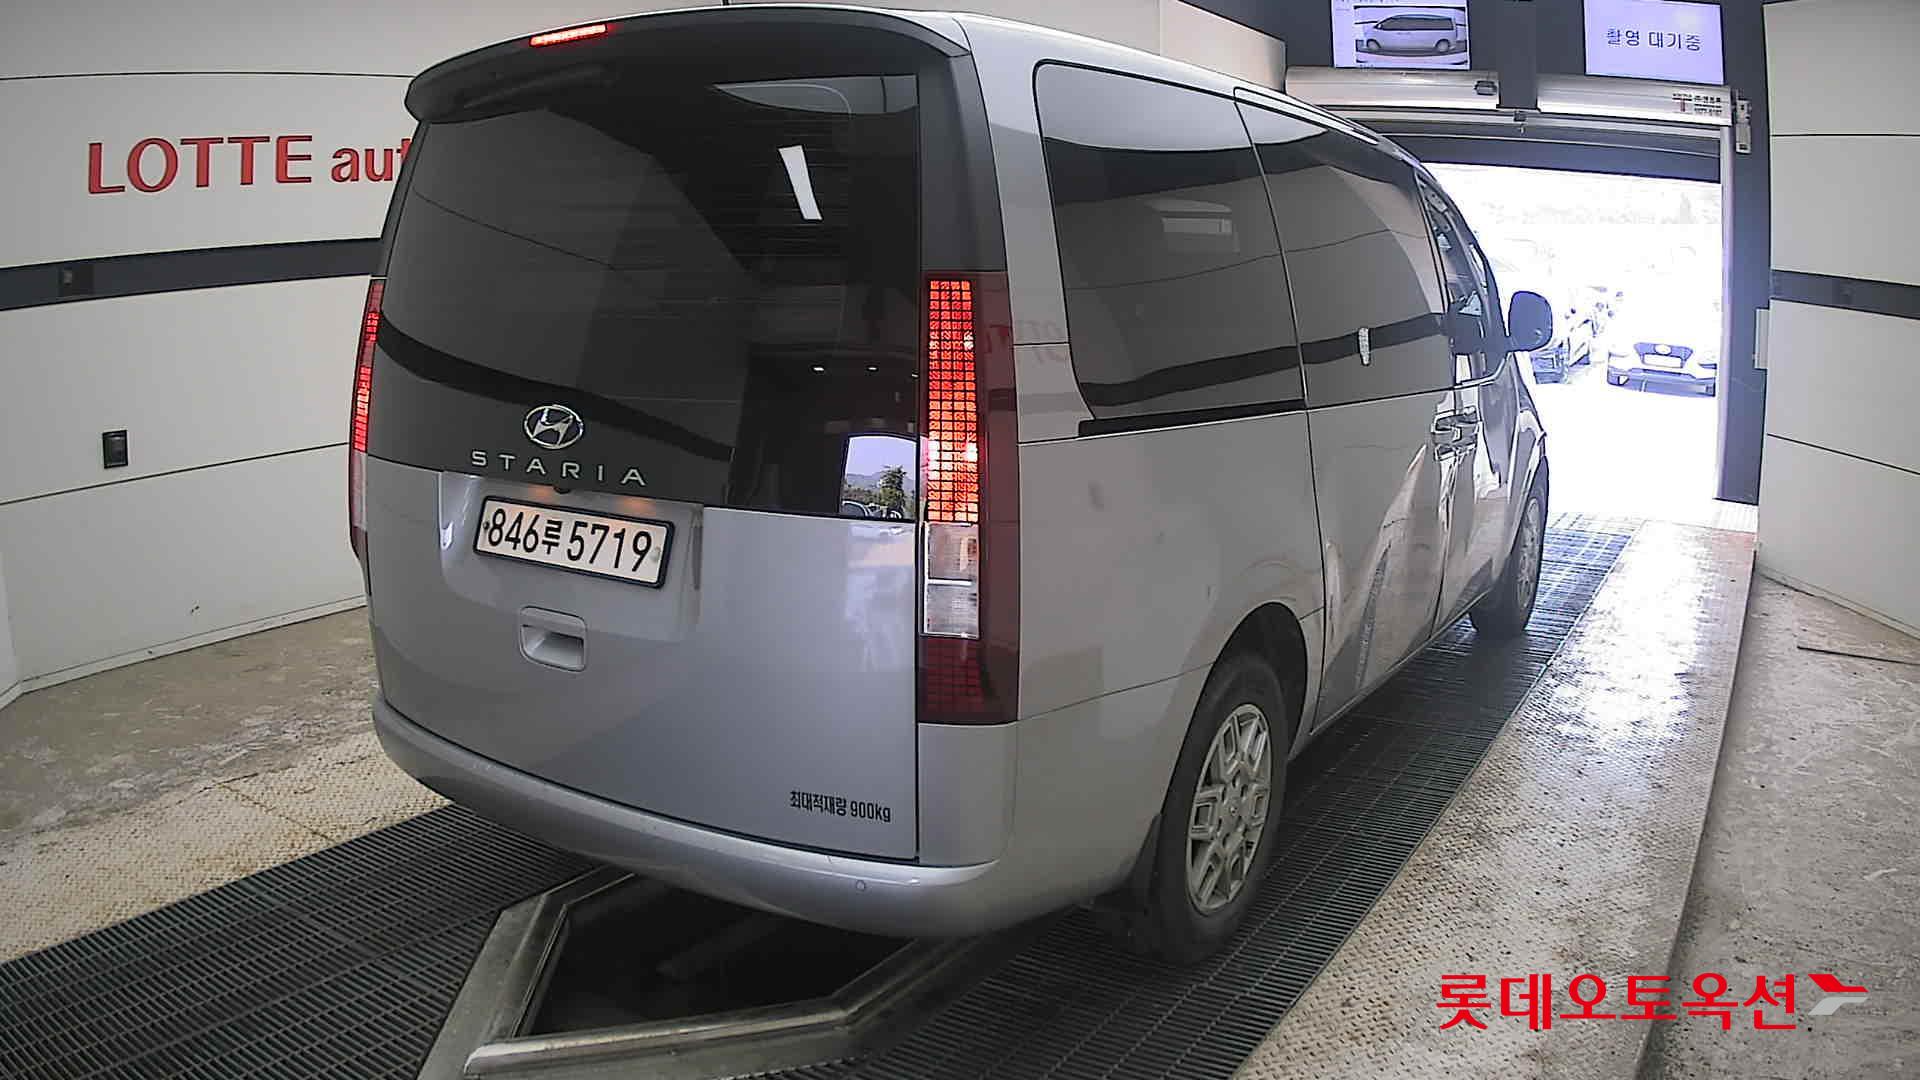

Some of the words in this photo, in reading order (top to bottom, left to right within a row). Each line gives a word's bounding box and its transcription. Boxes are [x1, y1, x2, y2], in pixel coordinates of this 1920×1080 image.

[1648, 31, 1701, 51] 대기중
[88, 135, 312, 194] LOTTE
[471, 451, 646, 485] STARIA
[790, 788, 847, 816] 최대적재량
